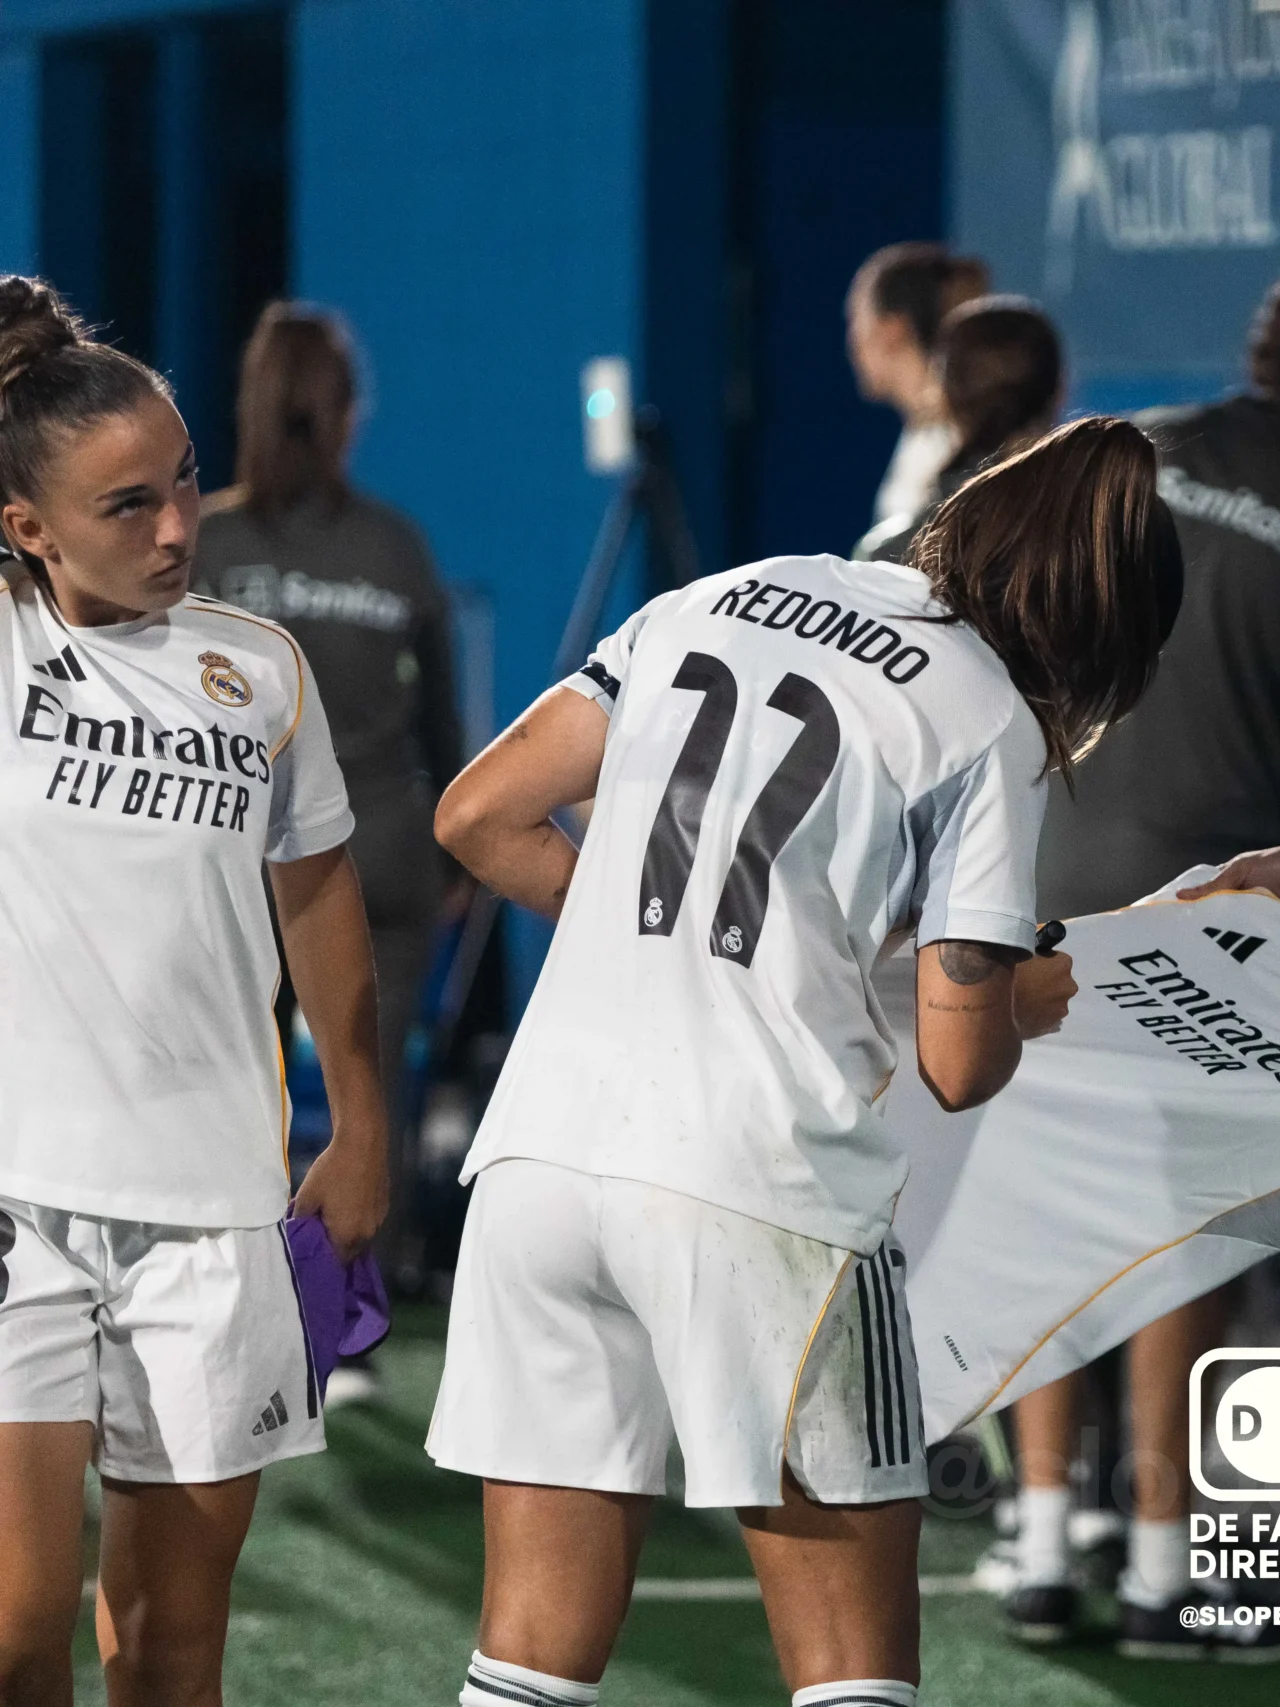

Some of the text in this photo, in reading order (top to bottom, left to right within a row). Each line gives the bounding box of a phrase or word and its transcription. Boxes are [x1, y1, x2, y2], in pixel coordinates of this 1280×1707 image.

[709, 579, 930, 685] REDONDO
[19, 683, 270, 785] Emirates
[46, 755, 250, 833] FLY BETTER
[1094, 981, 1248, 1076] FLY BETTER
[943, 1334, 969, 1372] AEROREADY
